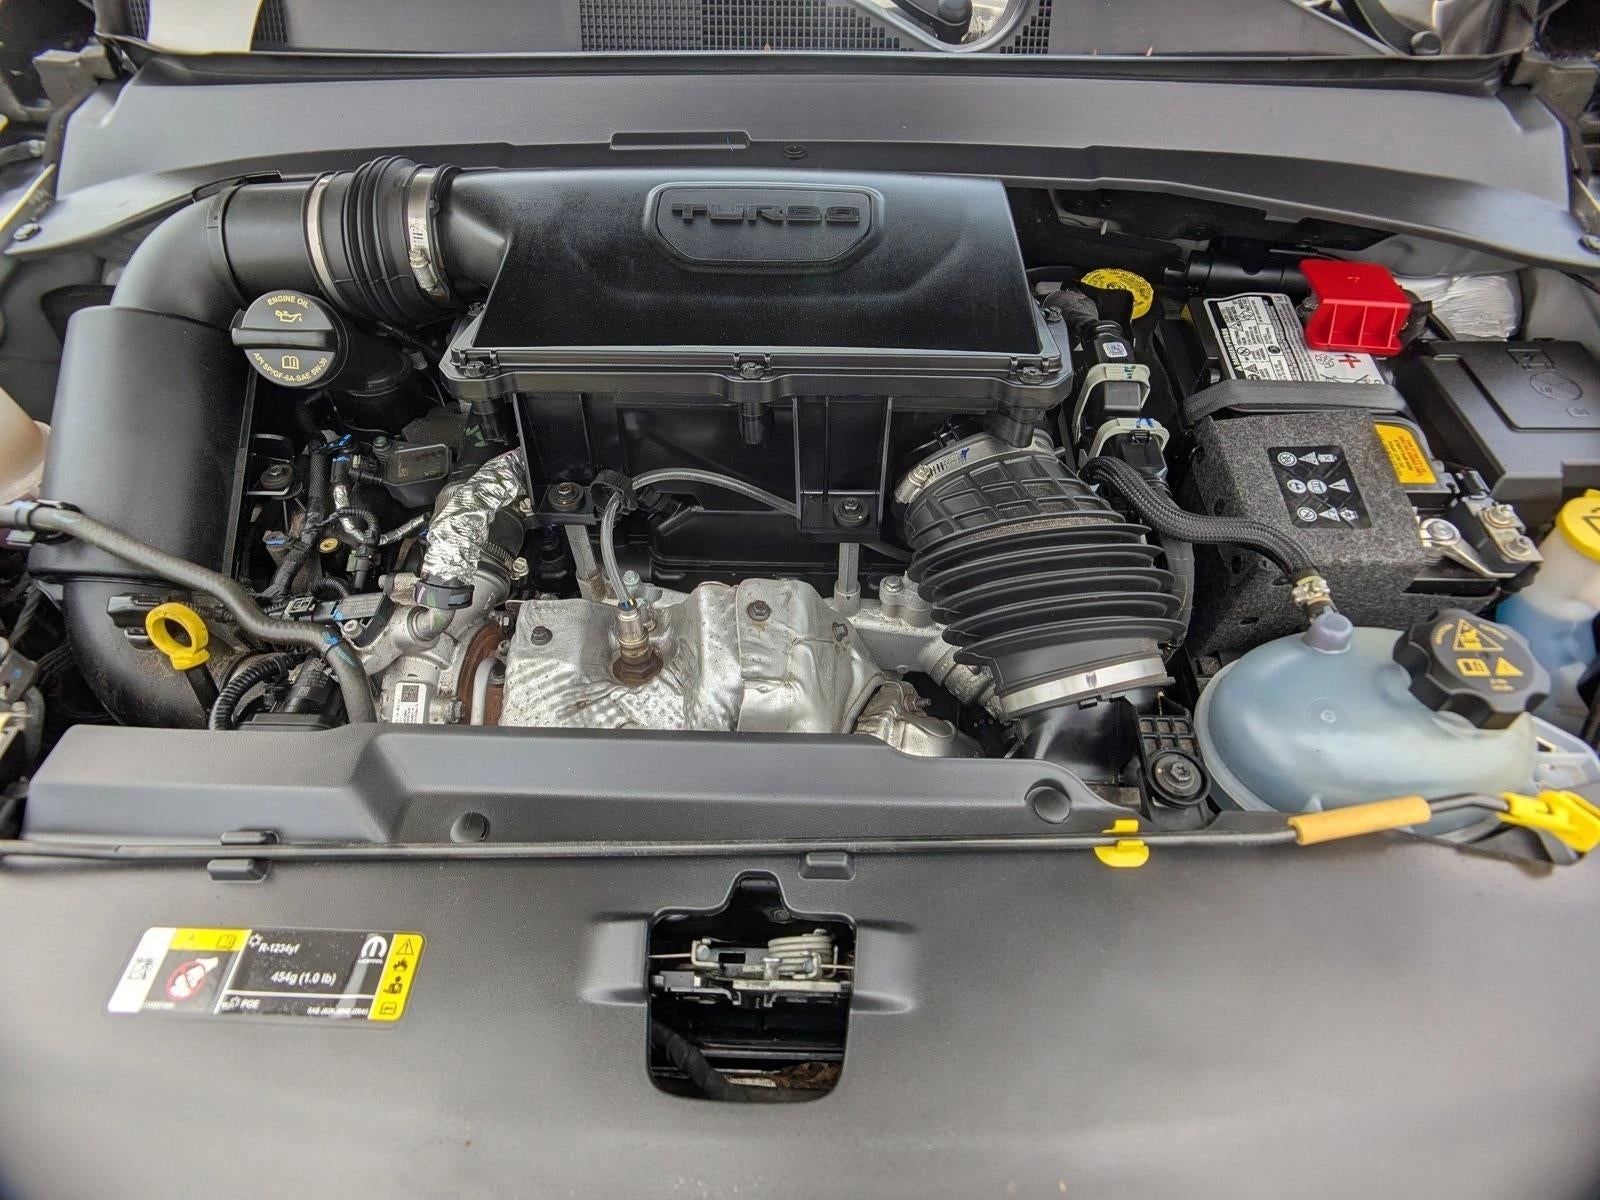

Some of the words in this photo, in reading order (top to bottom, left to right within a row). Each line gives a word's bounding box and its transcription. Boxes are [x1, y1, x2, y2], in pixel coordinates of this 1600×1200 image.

[670, 202, 861, 224] TURBO
[267, 294, 296, 306] ENGINE
[296, 297, 310, 309] OIL
[253, 352, 264, 364] API
[311, 357, 327, 375] 5W-30
[258, 942, 302, 956] R-1234yf
[270, 970, 299, 985] 454g
[299, 971, 321, 986] (1.0
[321, 972, 338, 987] lb)
[239, 998, 261, 1010] POE
